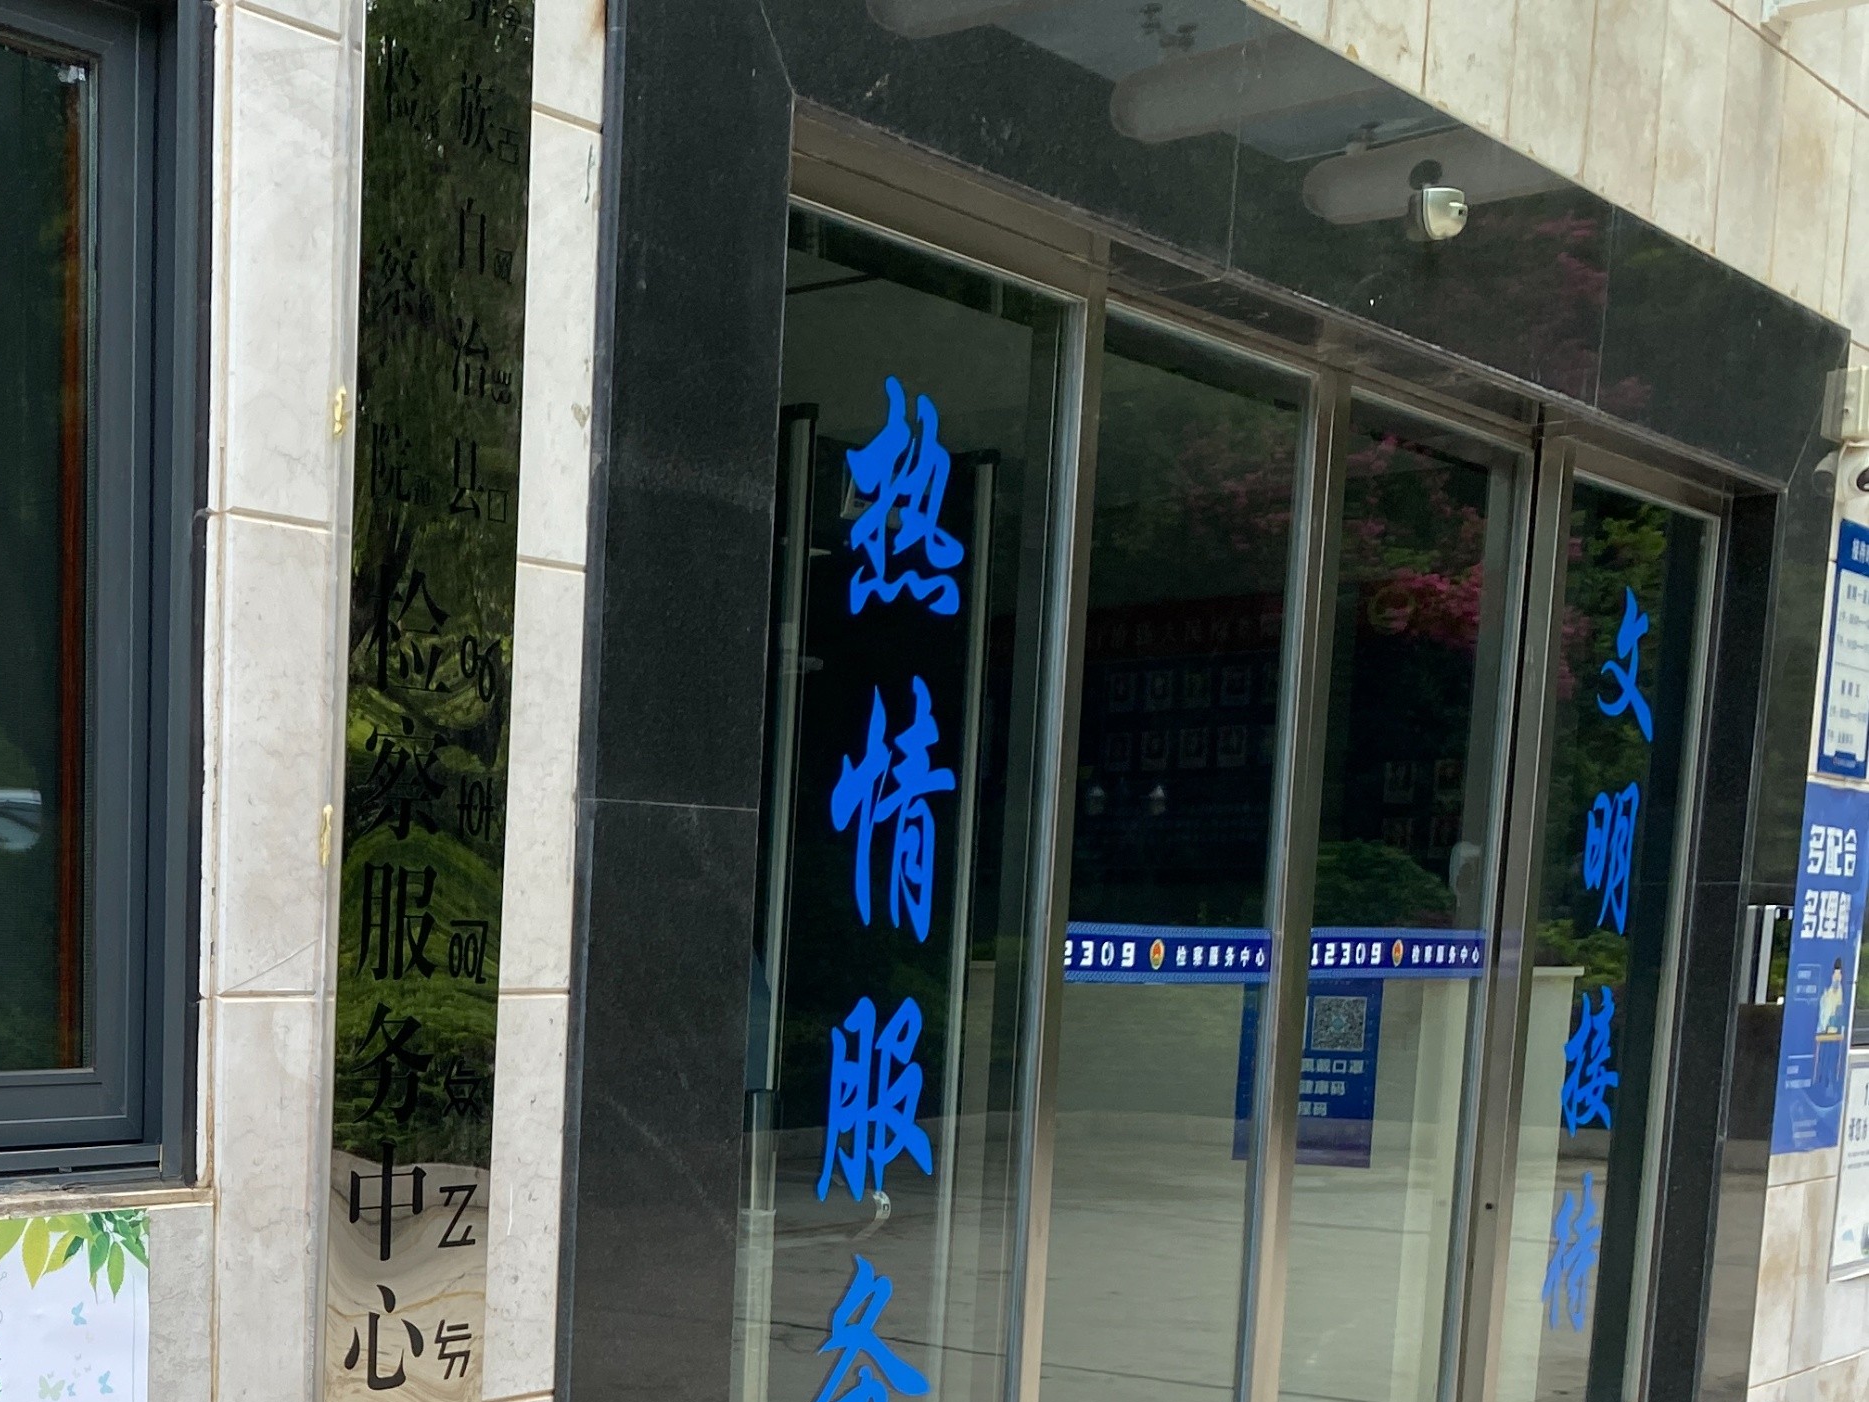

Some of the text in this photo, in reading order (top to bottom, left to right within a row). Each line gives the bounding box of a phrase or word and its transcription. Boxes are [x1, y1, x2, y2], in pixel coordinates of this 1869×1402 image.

[344, 562, 450, 1391] 检察服务中心
[1310, 941, 1382, 966] 12309
[1542, 586, 1654, 1333] 文明接待
[1806, 824, 1857, 877] 多配合
